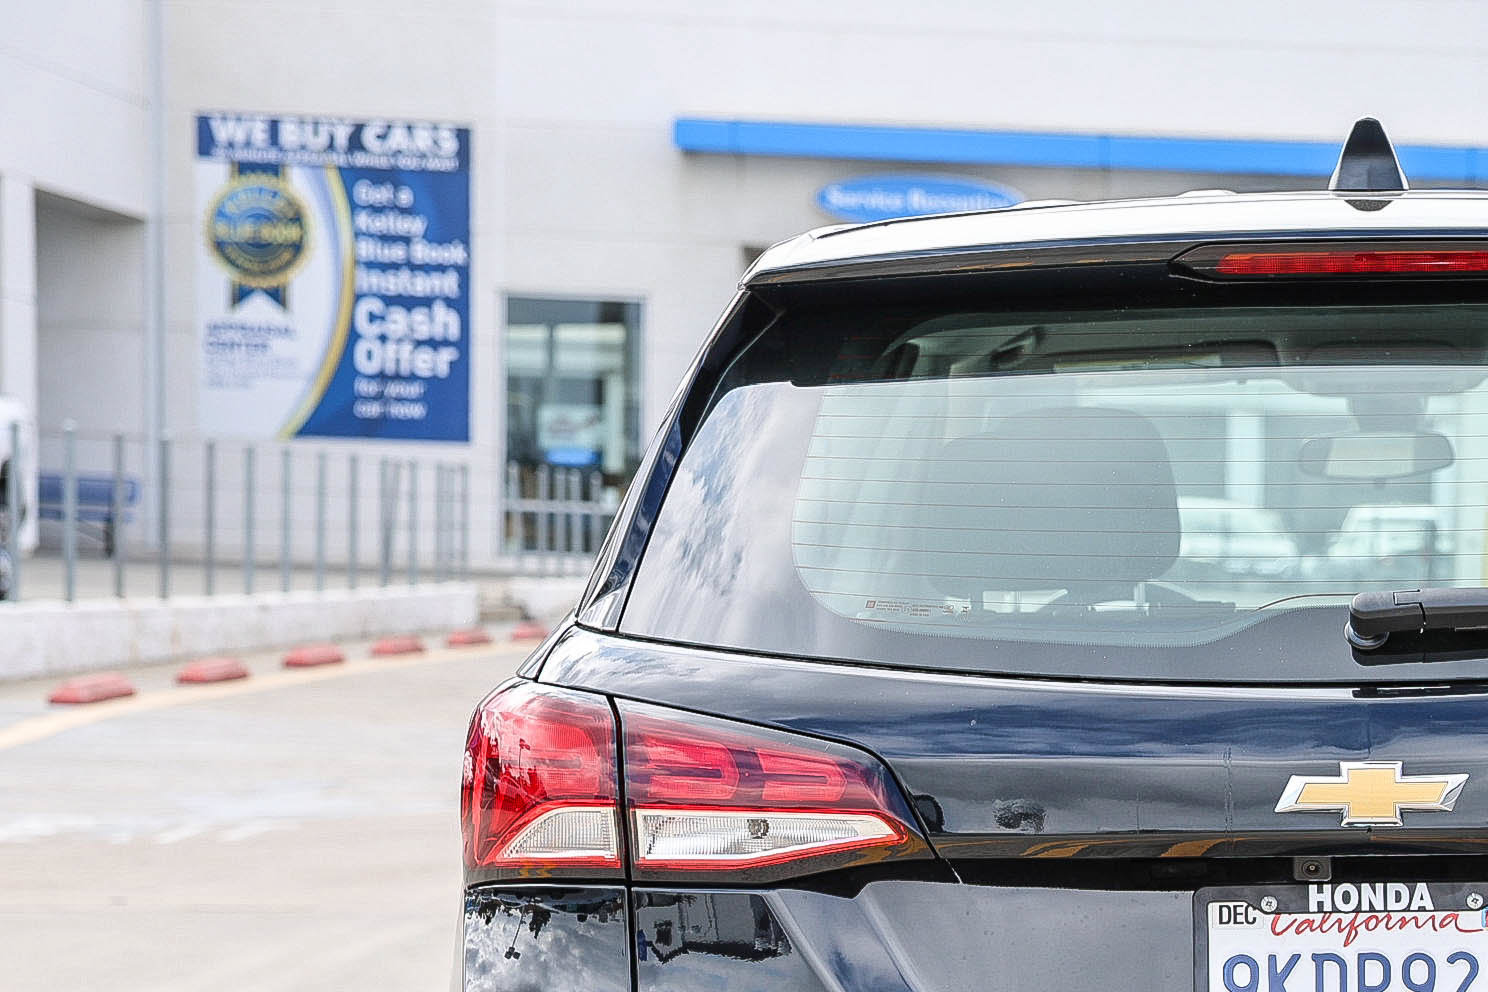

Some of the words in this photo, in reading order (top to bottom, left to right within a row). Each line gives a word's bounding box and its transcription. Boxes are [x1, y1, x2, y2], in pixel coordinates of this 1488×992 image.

[209, 118, 271, 147] WE
[278, 120, 354, 152] BUY
[361, 122, 460, 157] CARS
[353, 179, 395, 207] Get
[354, 209, 427, 239] Kelley
[355, 235, 408, 264] Blue
[410, 238, 467, 267] Book
[355, 264, 461, 298] Instant
[353, 295, 461, 341] Cash
[353, 338, 460, 379] Offer
[1308, 882, 1435, 912] HONDA
[1218, 904, 1257, 925] DEC
